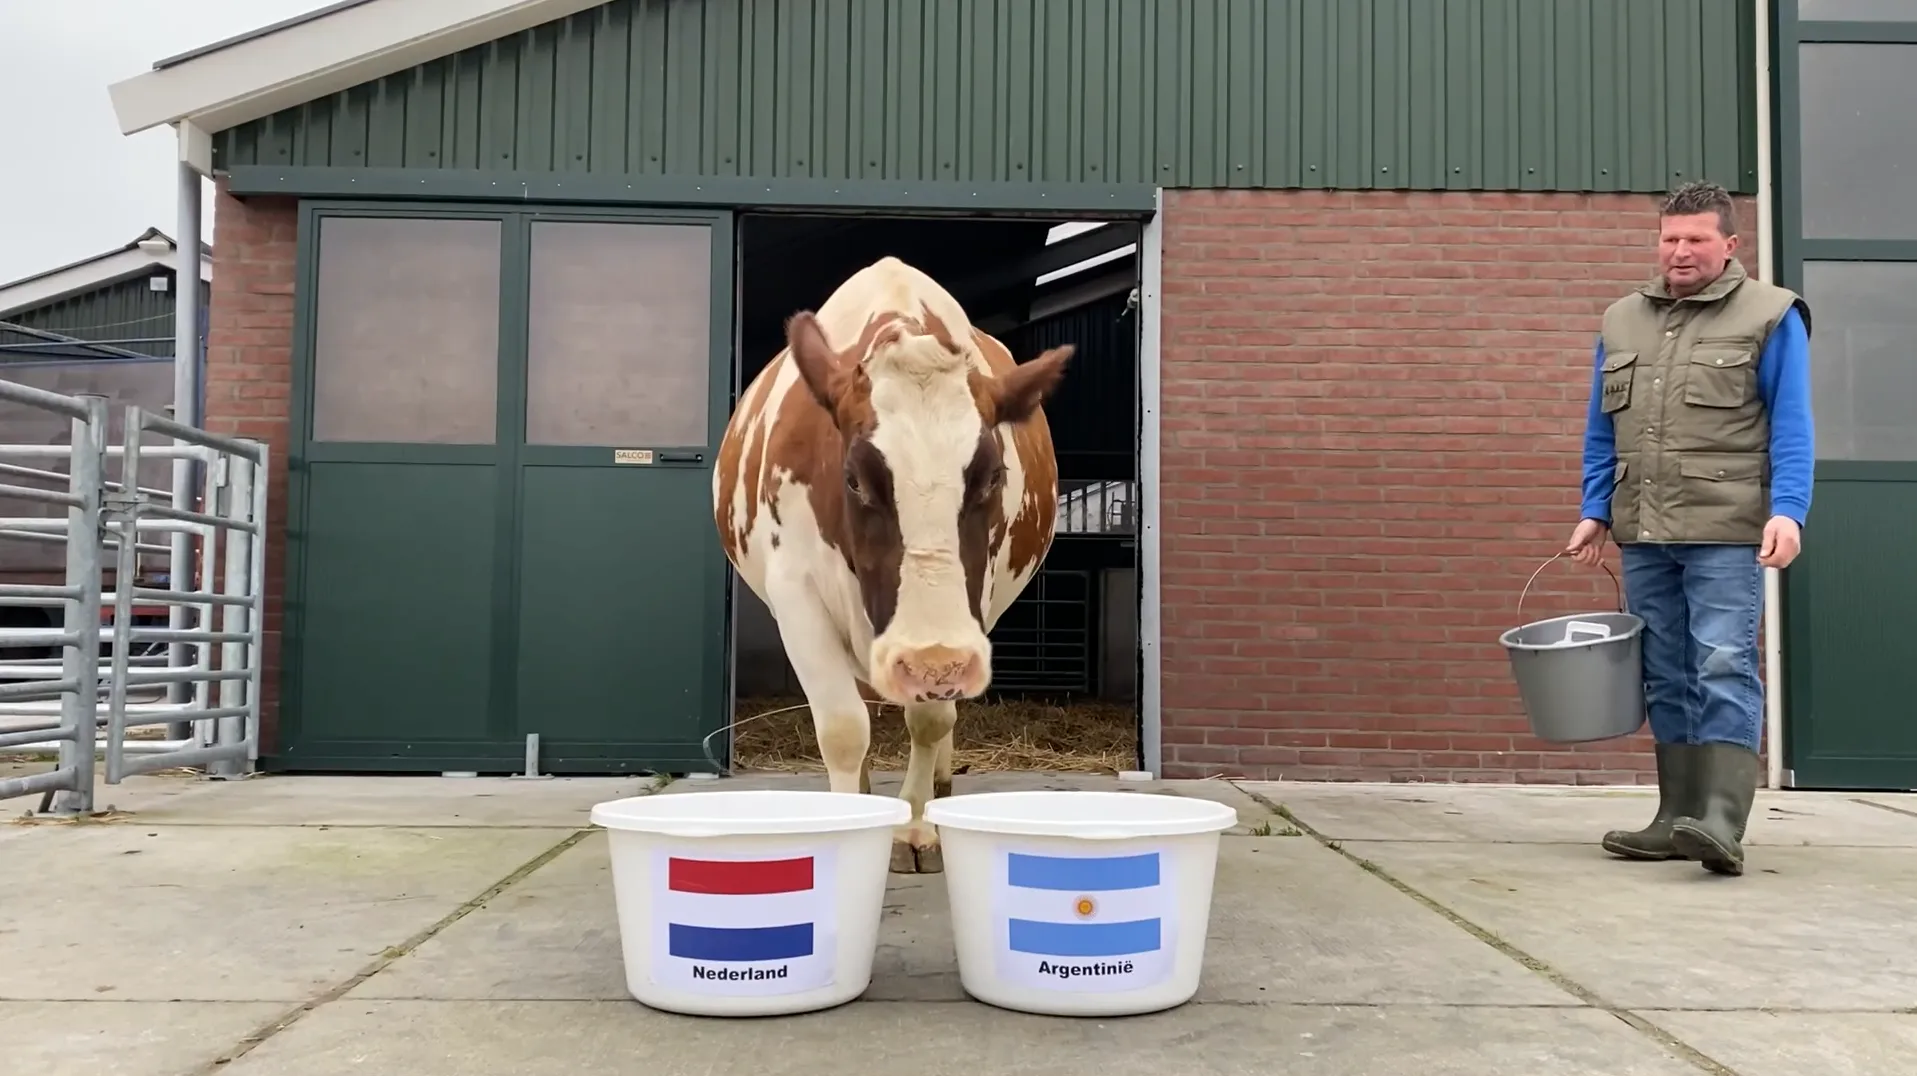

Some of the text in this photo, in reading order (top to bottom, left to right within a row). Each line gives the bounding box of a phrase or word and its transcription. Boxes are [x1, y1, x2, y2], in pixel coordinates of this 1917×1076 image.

[616, 451, 645, 459] SALCO
[692, 964, 788, 981] Nederland
[1038, 960, 1134, 979] Argentinië
